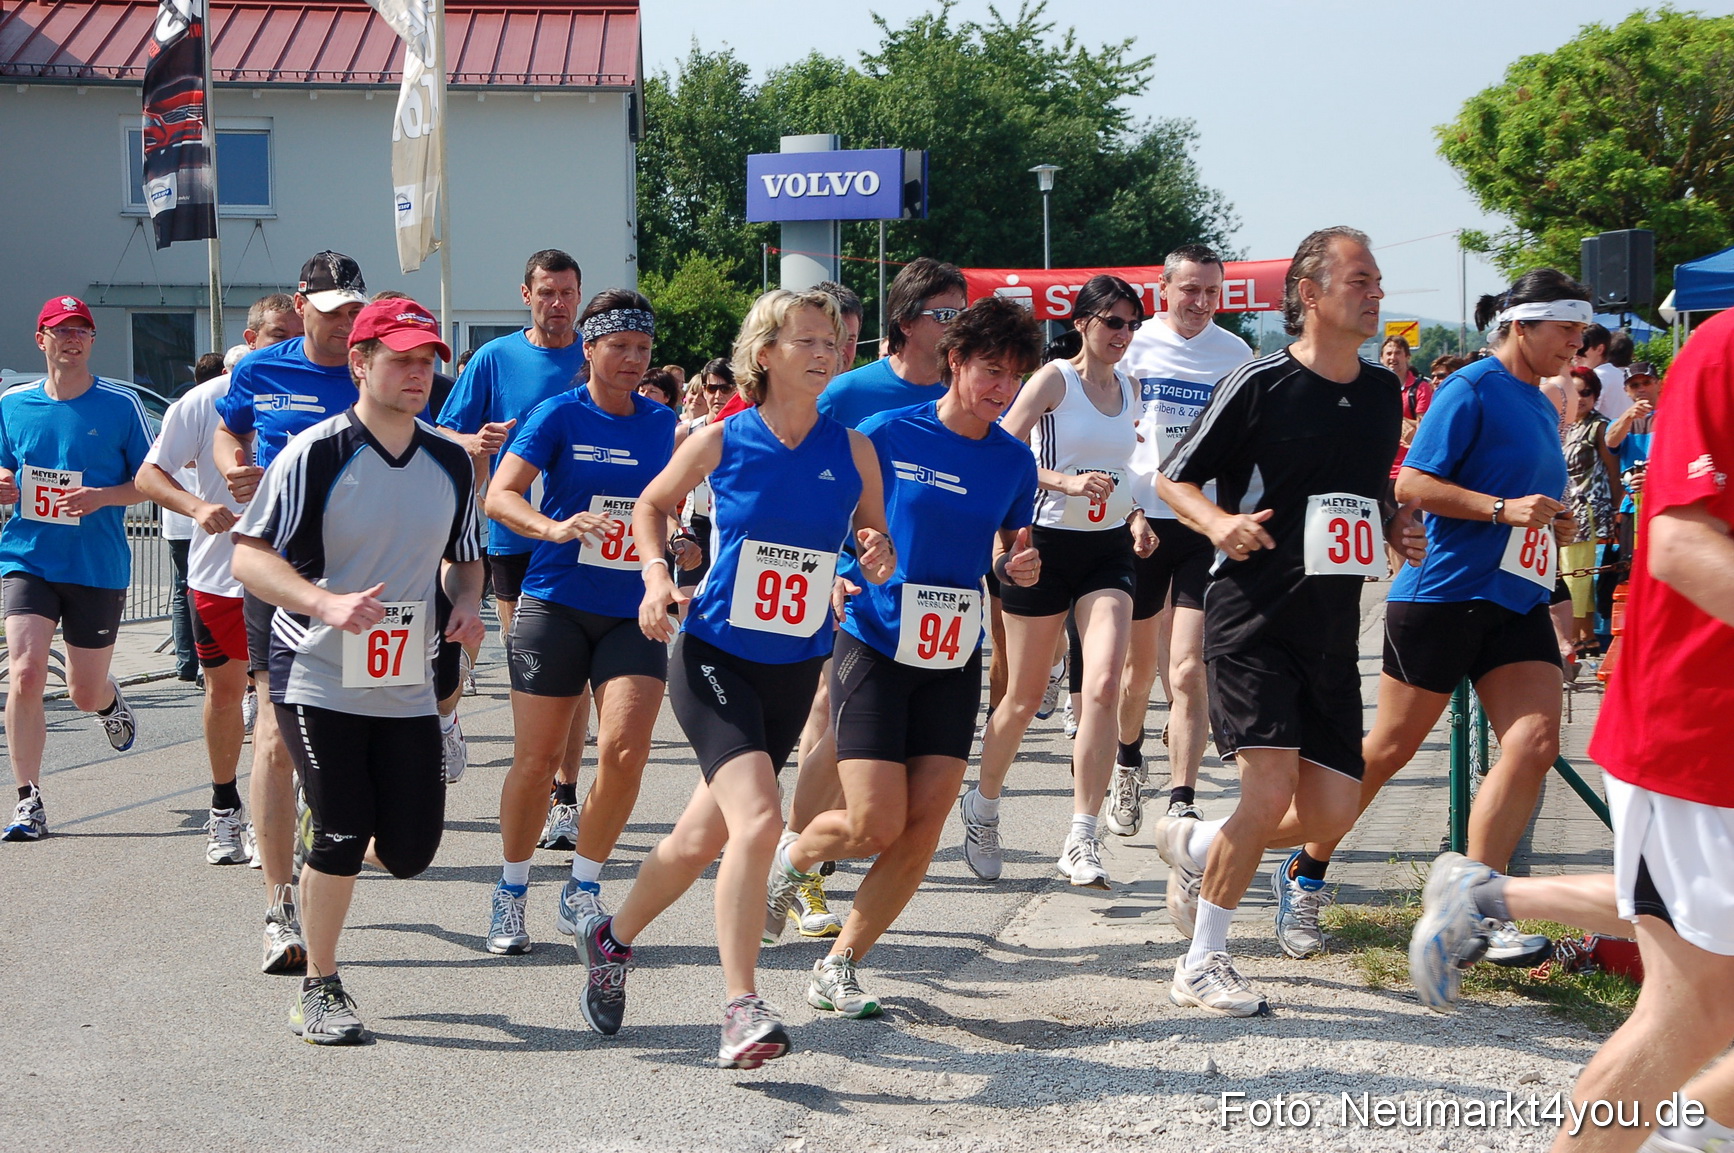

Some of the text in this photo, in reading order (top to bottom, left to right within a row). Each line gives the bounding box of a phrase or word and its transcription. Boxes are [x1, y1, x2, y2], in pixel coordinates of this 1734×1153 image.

[761, 170, 880, 198] VOLVO
[1179, 406, 1186, 416] &
[31, 469, 58, 479] MEYER
[31, 476, 58, 484] WERBUNG
[35, 485, 66, 518] 57
[1321, 498, 1358, 508] MEYER
[1321, 507, 1359, 515] WERBUNG
[601, 519, 640, 562] 82
[1328, 517, 1374, 565] 30
[757, 545, 800, 561] MEYER
[1519, 527, 1549, 577] 83
[755, 556, 799, 569] WERBUNG
[755, 569, 808, 625] 93
[917, 590, 957, 602] MEYER
[917, 600, 956, 611] WERBUNG
[917, 612, 960, 660] 94
[367, 629, 409, 678] 67
